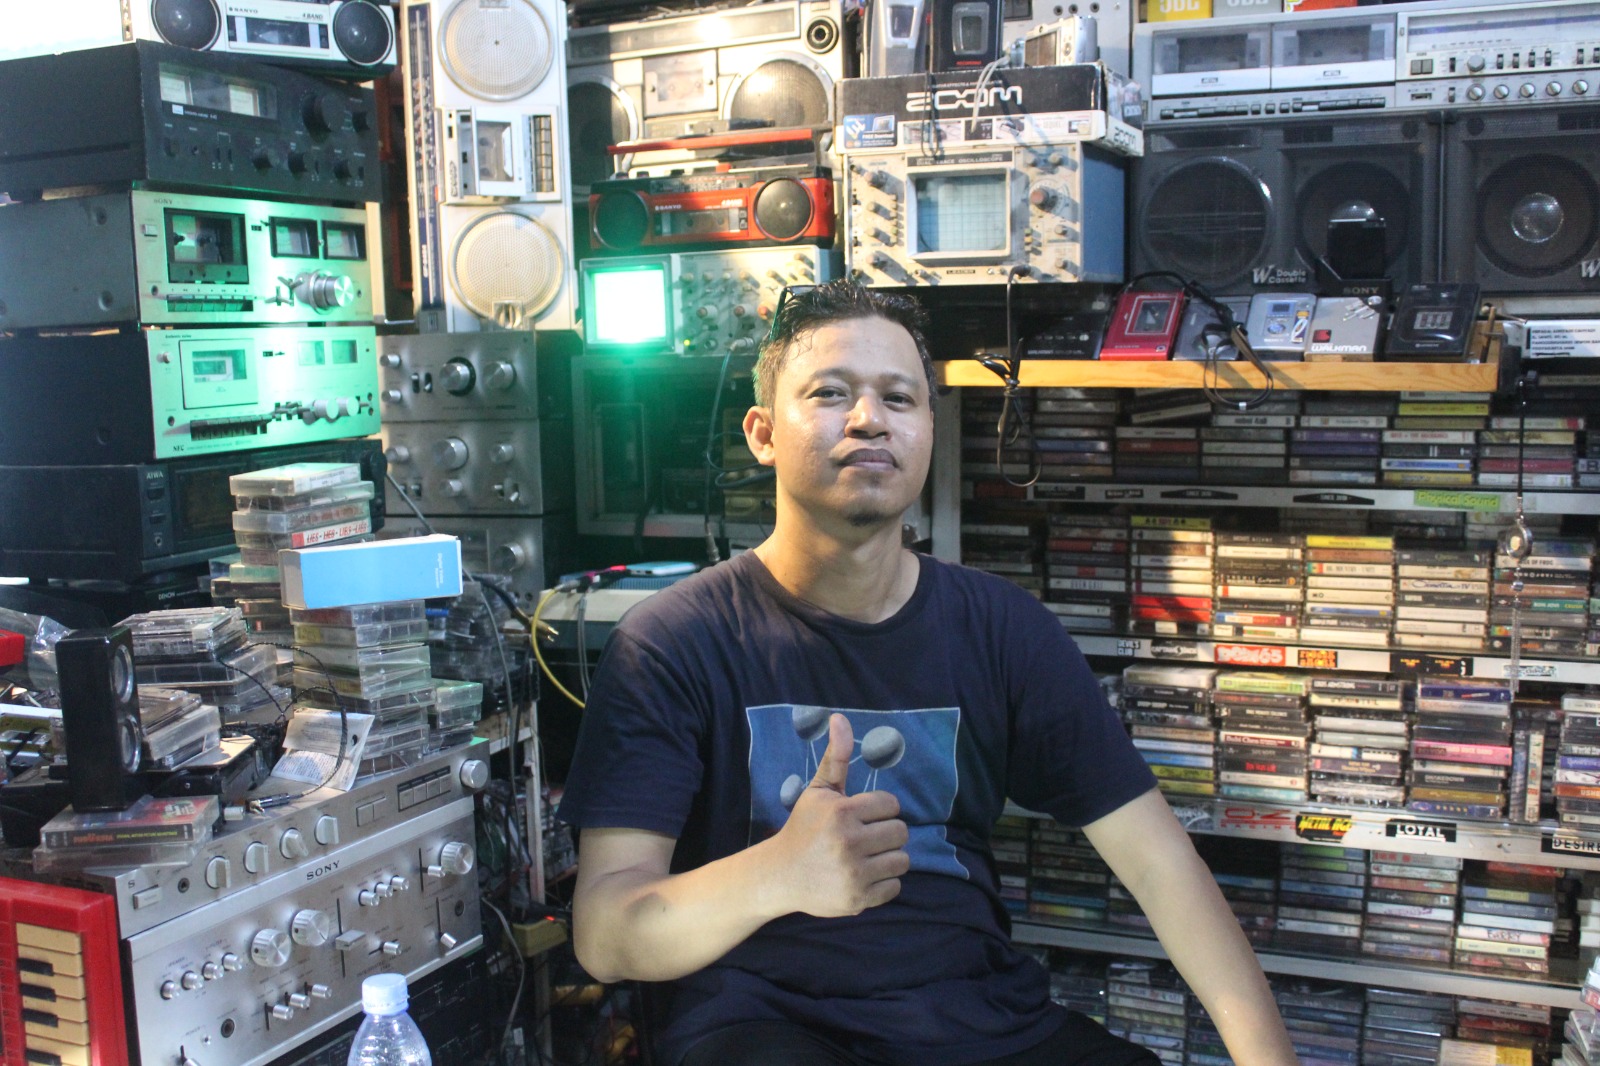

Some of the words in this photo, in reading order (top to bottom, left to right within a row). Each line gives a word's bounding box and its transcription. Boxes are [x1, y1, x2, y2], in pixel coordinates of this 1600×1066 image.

[905, 86, 1023, 112] ZOOM
[1276, 269, 1306, 277] Double
[1268, 276, 1306, 284] Cassette
[1343, 286, 1380, 295] SONY
[146, 471, 164, 480] AIWA
[1417, 490, 1460, 506] Physical
[1464, 494, 1498, 507] Sound
[158, 592, 176, 601] DENON
[1396, 824, 1445, 838] LOYAL
[306, 860, 340, 880] SONY
